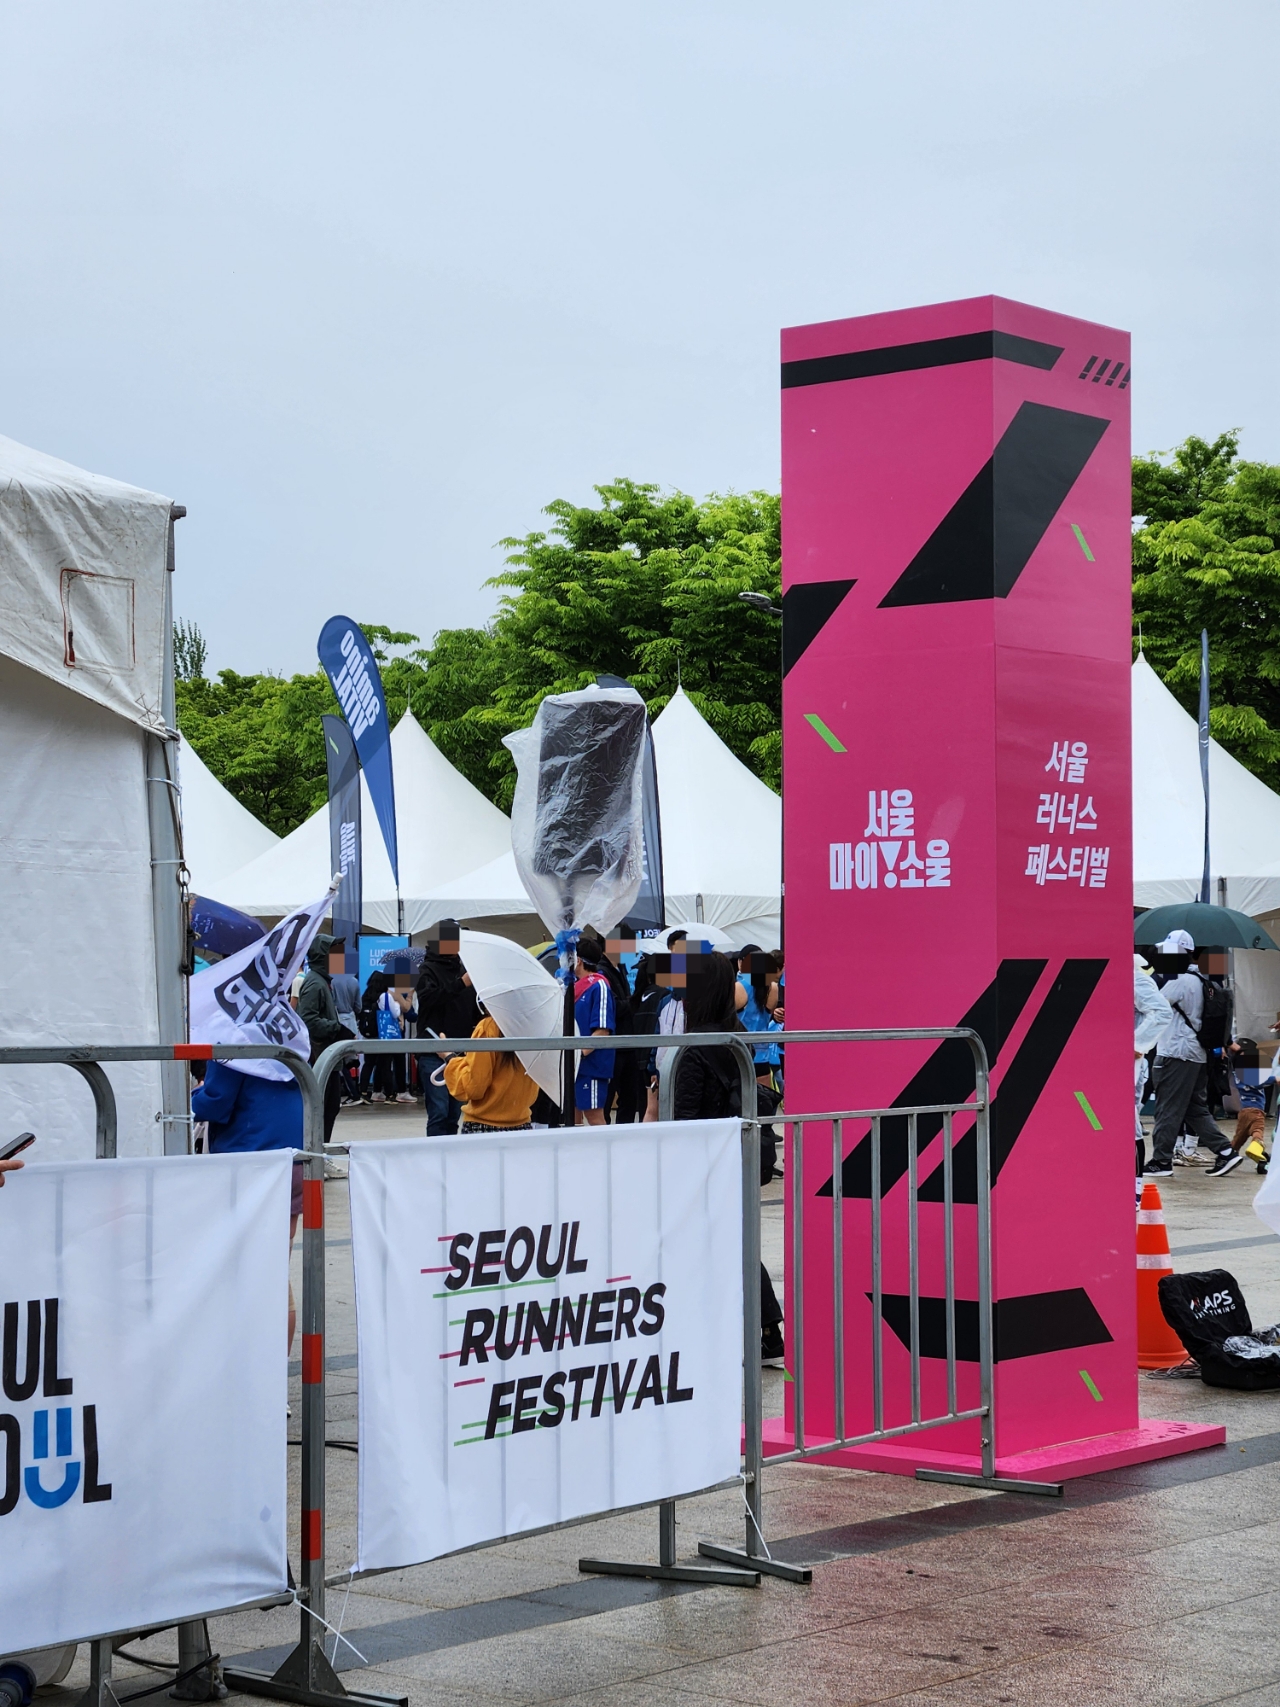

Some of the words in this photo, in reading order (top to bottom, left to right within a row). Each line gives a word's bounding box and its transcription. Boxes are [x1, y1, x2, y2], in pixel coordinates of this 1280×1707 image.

[1044, 740, 1089, 784] 서울
[864, 789, 914, 838] 서울
[1036, 791, 1097, 835] 러너스
[1025, 843, 1110, 888] 페스티벌
[444, 1220, 588, 1291] SEOUL
[459, 1282, 667, 1367] RUNNERS
[484, 1351, 694, 1440] FESTIVAL
